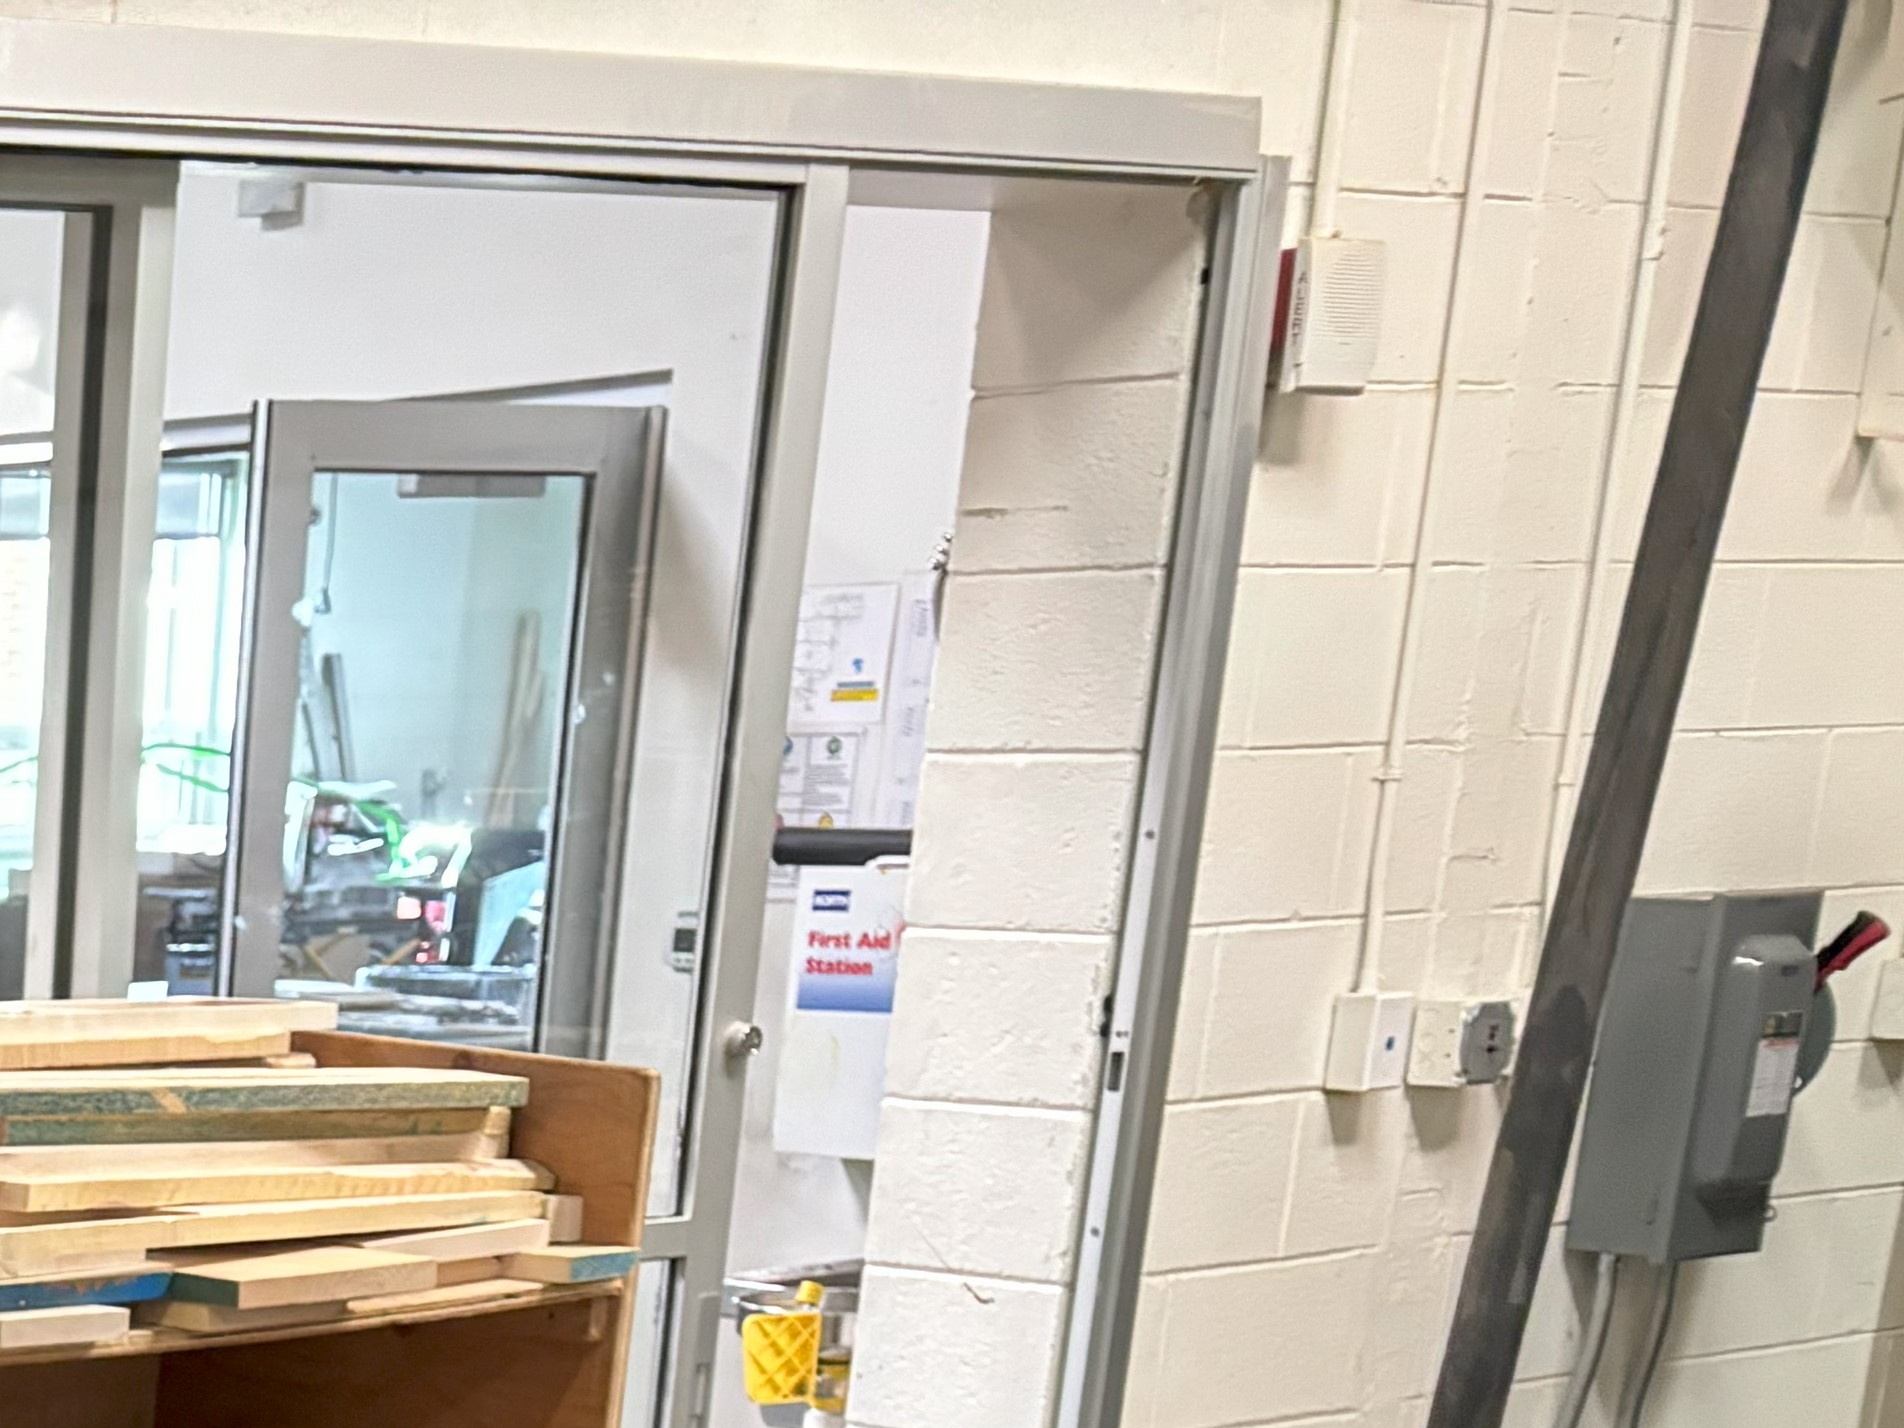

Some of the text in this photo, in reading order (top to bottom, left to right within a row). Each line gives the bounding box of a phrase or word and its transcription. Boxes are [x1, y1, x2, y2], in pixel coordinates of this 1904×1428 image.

[808, 930, 892, 950] First Aid
[805, 956, 873, 976] Station
